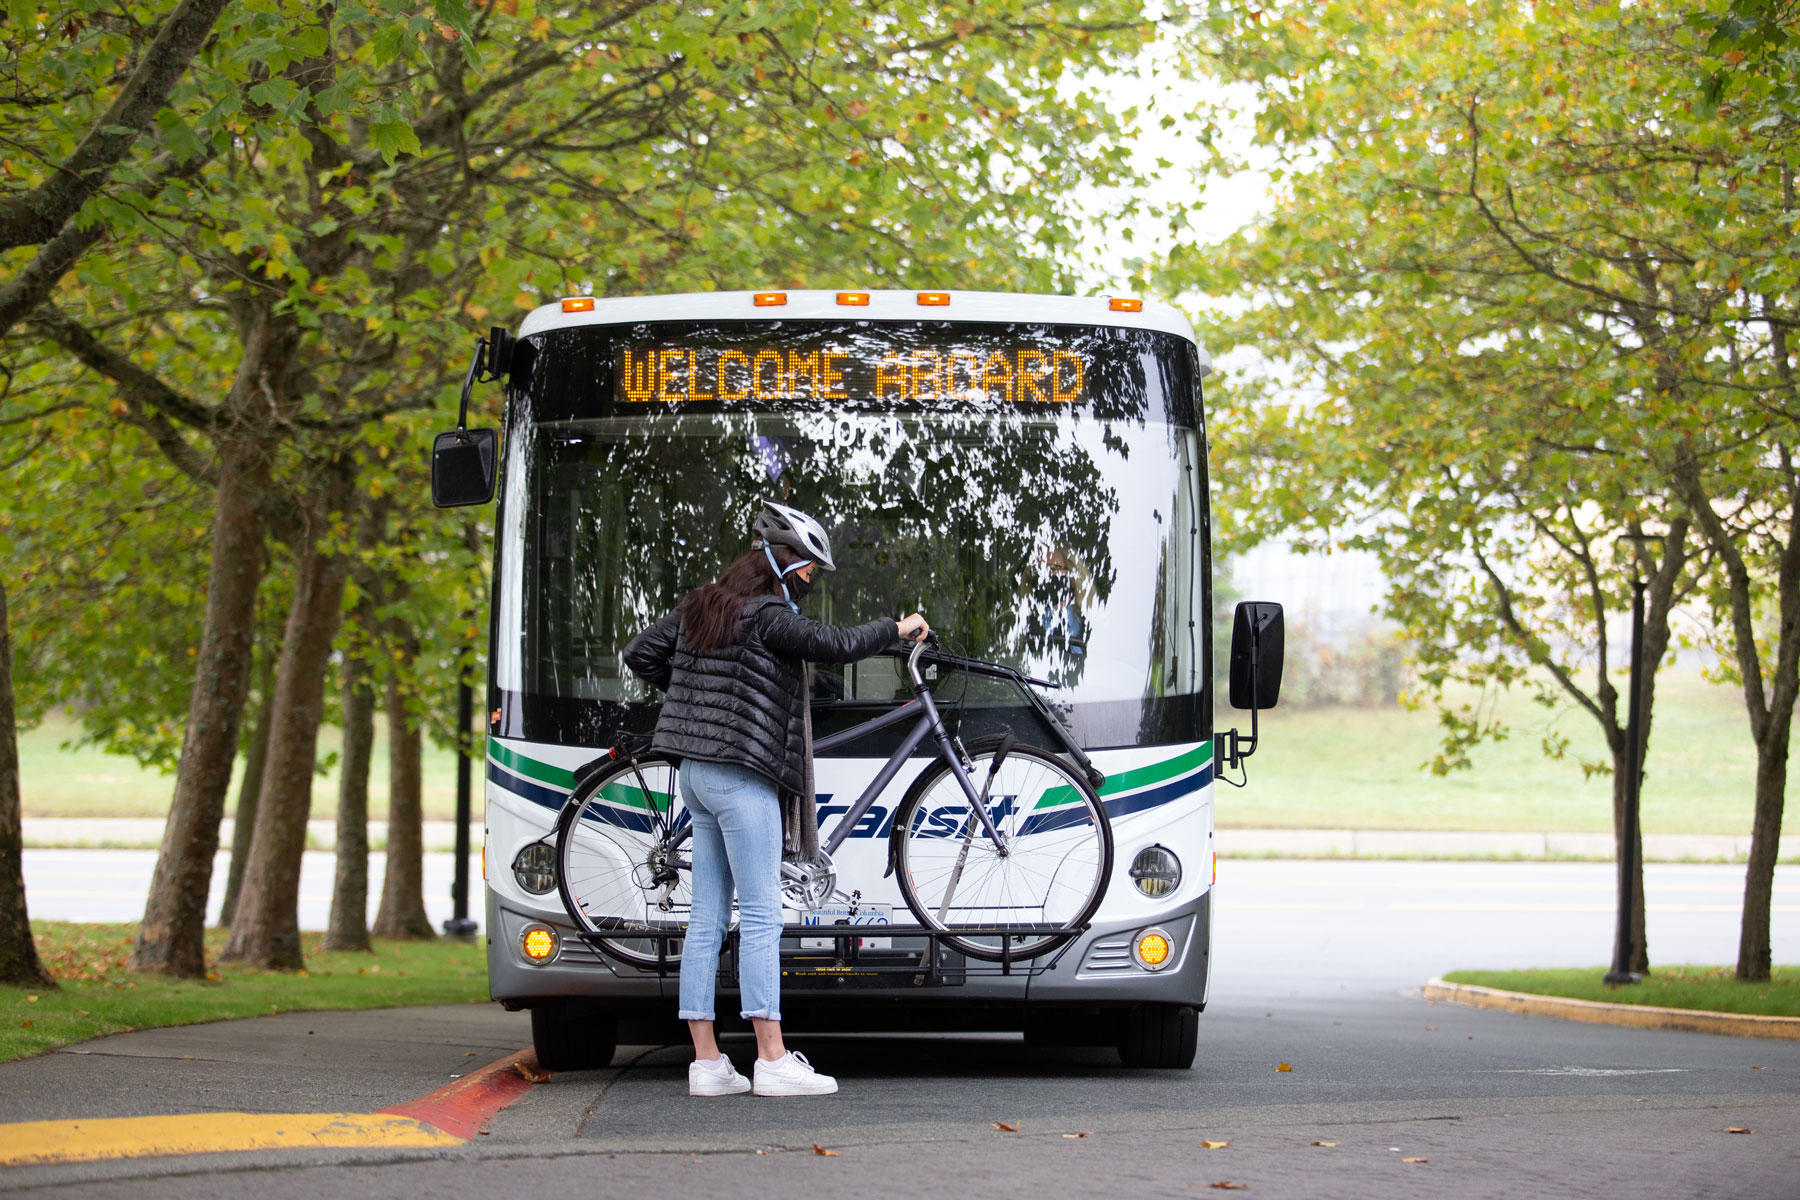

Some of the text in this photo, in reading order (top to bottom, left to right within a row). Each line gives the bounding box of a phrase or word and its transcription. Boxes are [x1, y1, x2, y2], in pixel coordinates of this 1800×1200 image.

[624, 349, 1083, 402] WELCOME ABOARD
[809, 416, 899, 447] 4071
